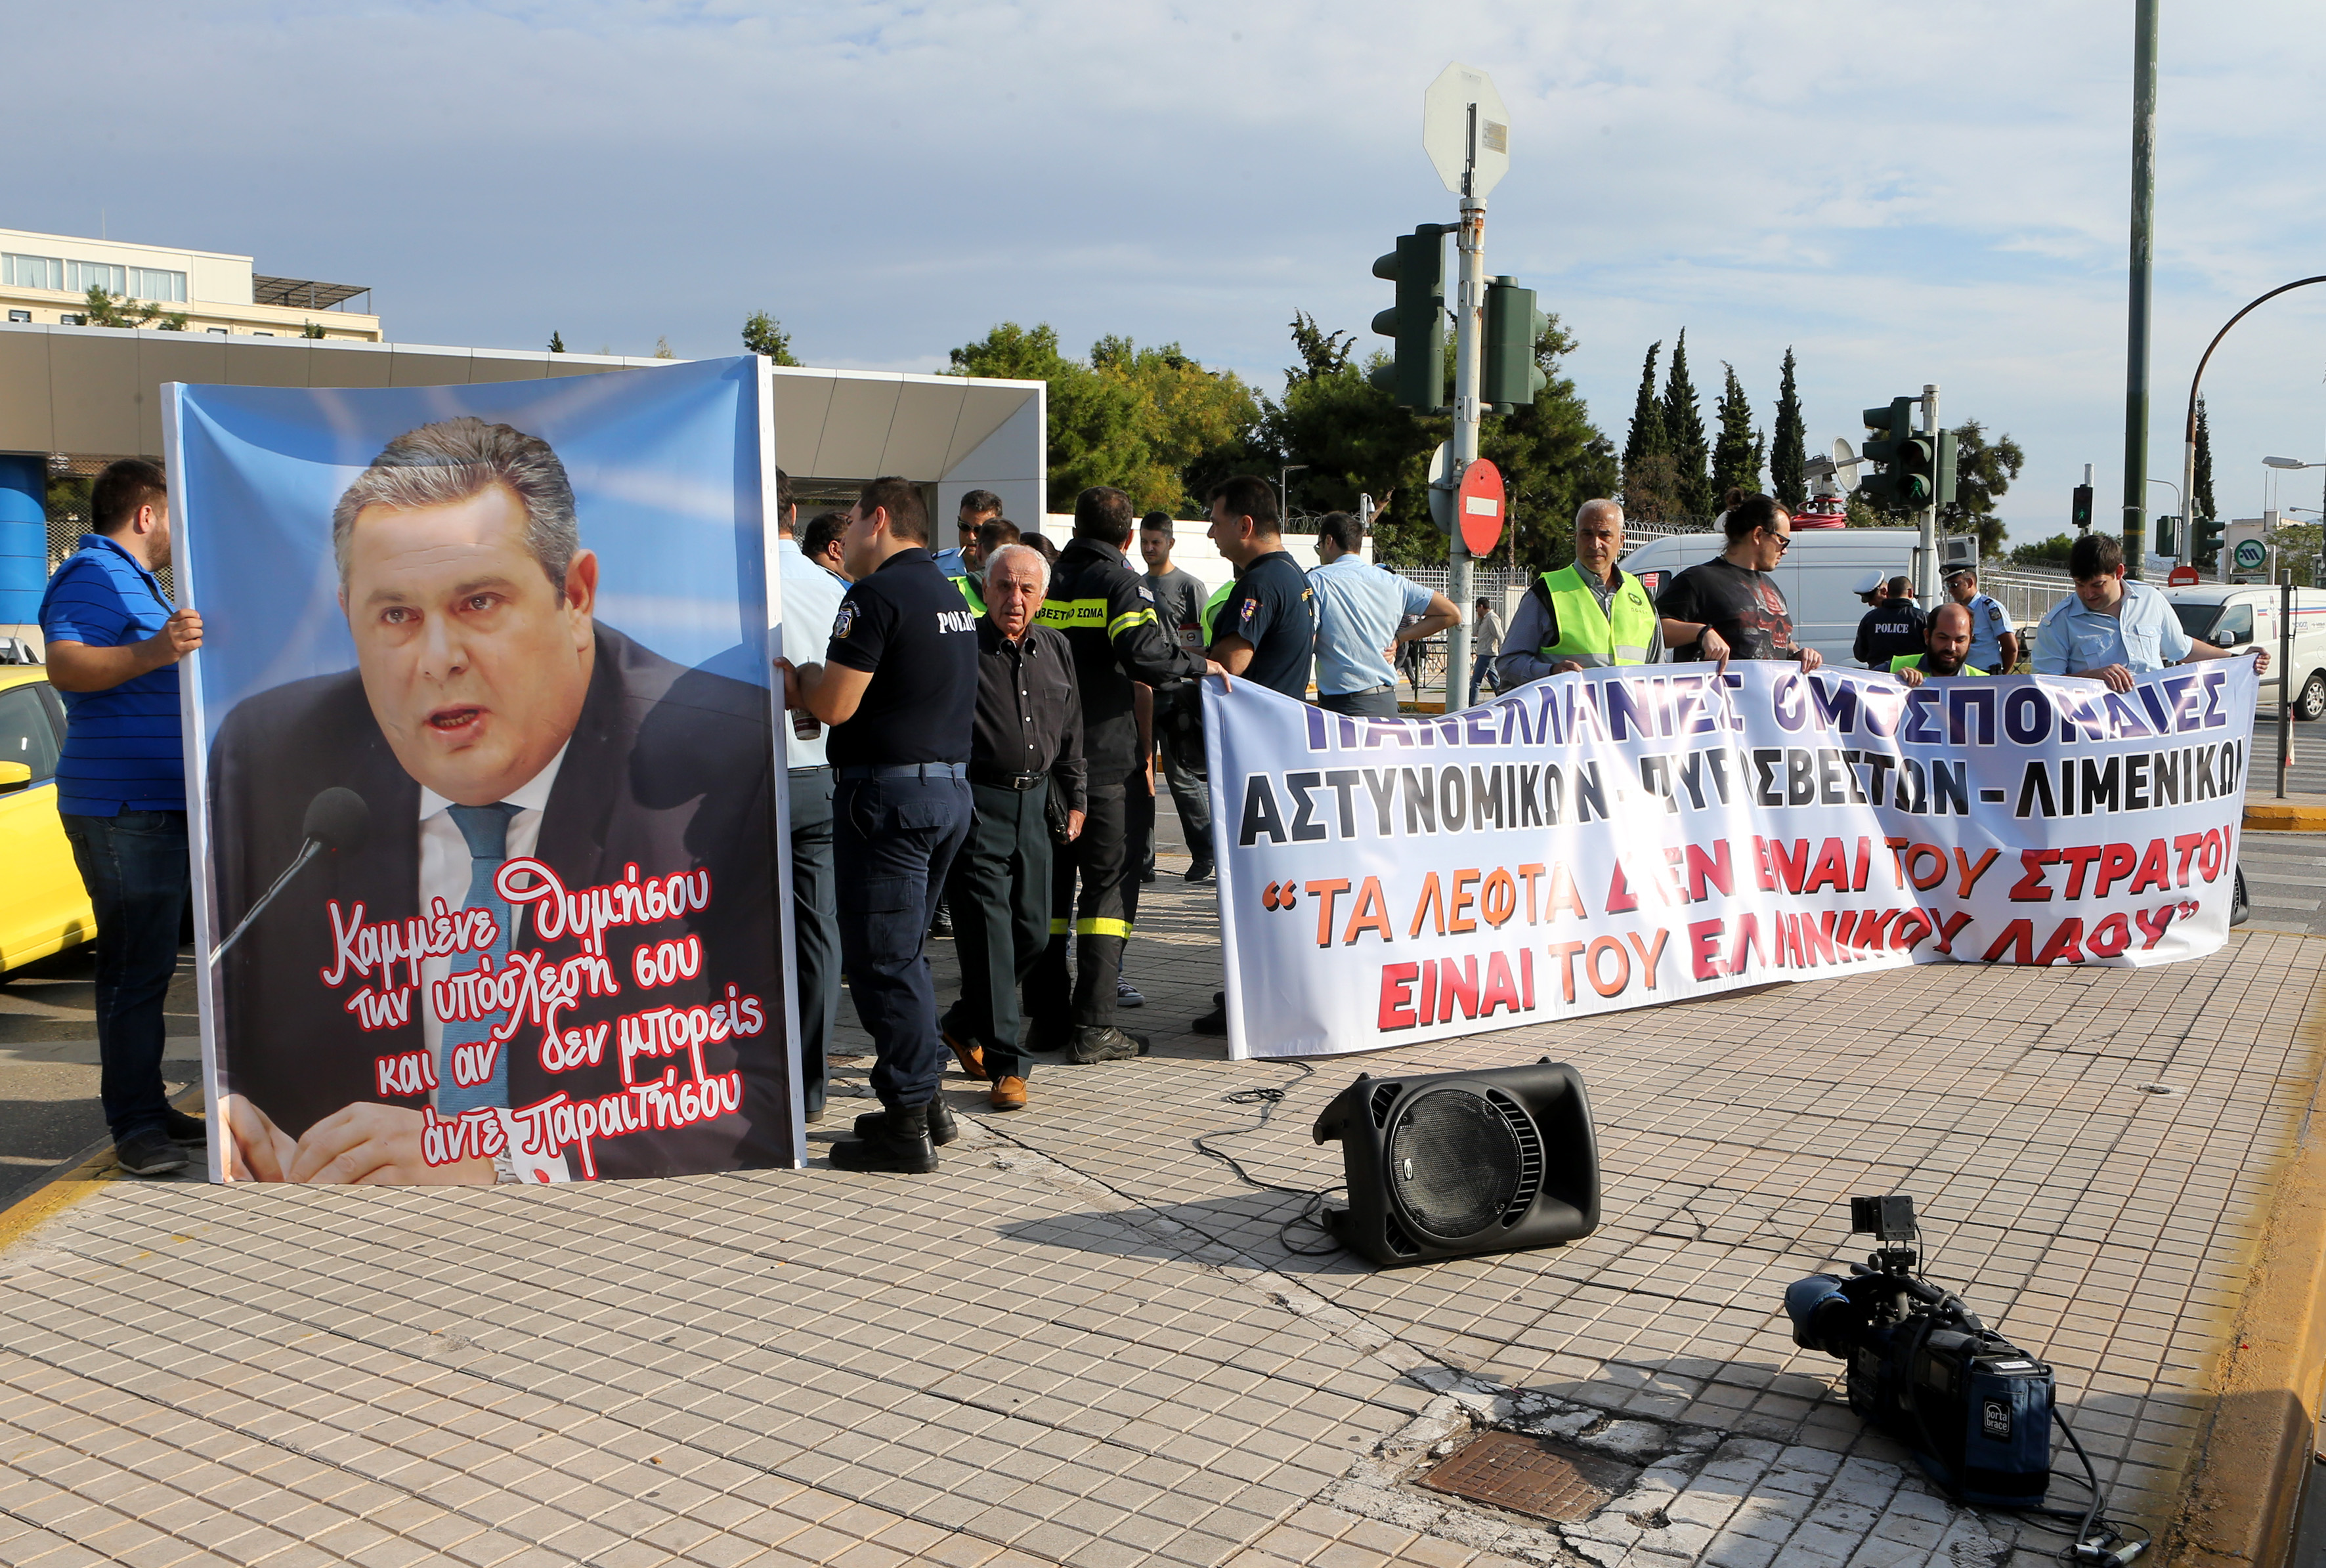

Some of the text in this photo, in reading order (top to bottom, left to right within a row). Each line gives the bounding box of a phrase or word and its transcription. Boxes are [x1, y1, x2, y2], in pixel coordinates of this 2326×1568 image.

[1077, 608, 1104, 618] ΣΩΜΑ
[1875, 623, 1908, 633] POLICE
[1773, 671, 2227, 746] ΟΜΟΣΠΟΝΔΙΕΣ
[1238, 760, 1610, 846] ΑΣΤΥΝΟΜΙΚΩΝ
[1408, 861, 1587, 940] ΛΕΦΤΑ
[1884, 836, 2001, 900] ΤΟΥ
[2008, 820, 2234, 902] ΣΤΡΑΤΟΥ
[322, 899, 498, 990] Καμμένε
[347, 985, 410, 1028] την
[635, 937, 699, 986] σου
[1377, 947, 1536, 1033] ΕΙΝΑΙ
[1547, 927, 1670, 1004] ΤΟΥ
[378, 985, 764, 1094] και αν δεν μπορείς
[423, 1106, 506, 1165] άντε
[1987, 1408, 2008, 1422] porta
[1987, 1418, 2008, 1431] brace
